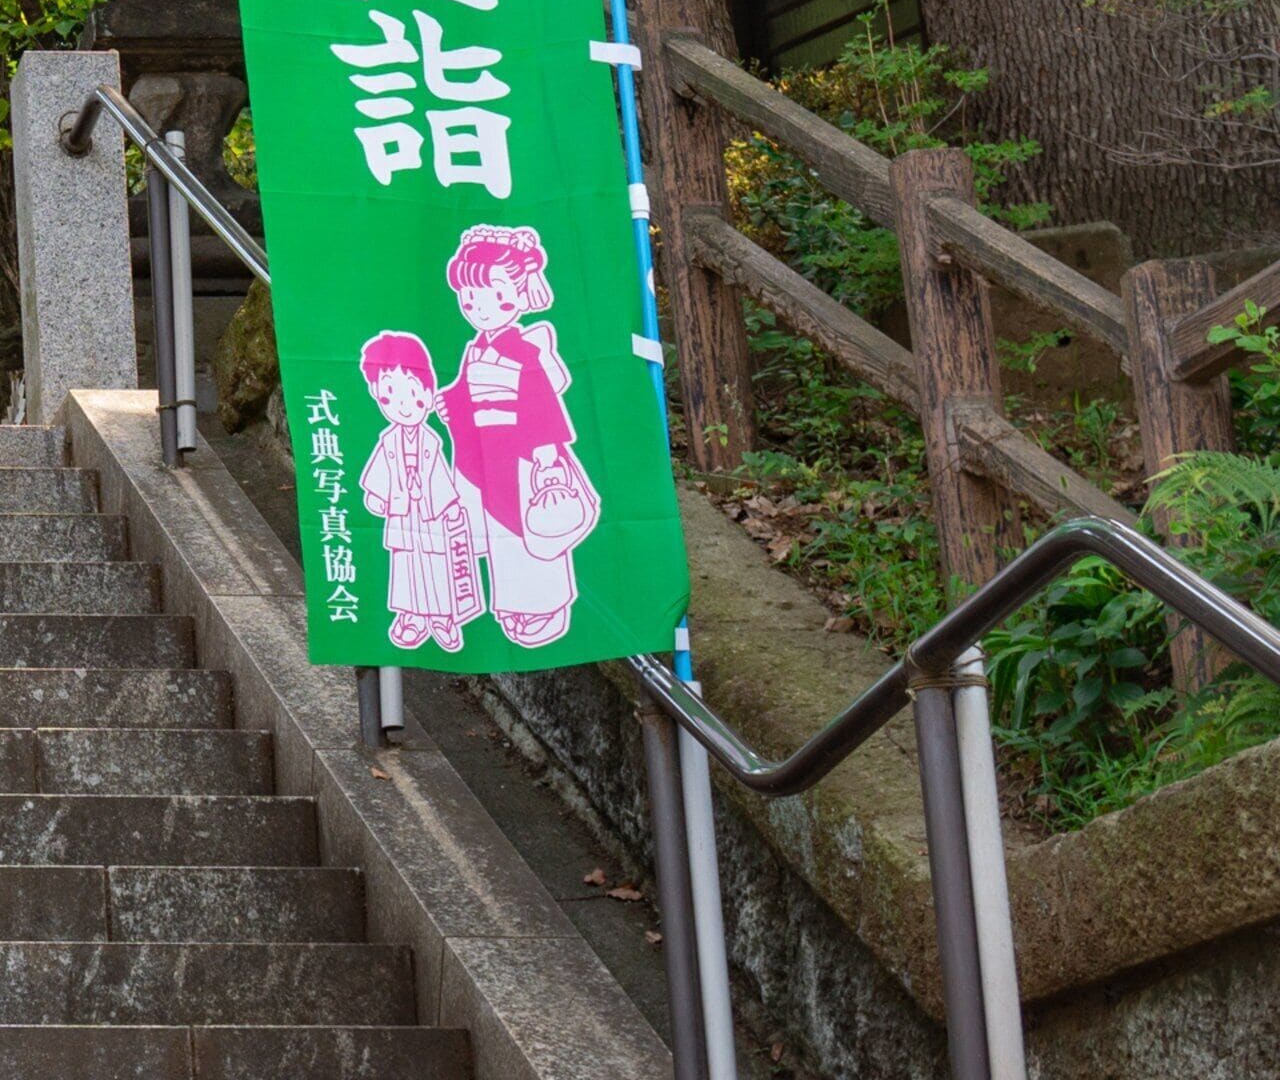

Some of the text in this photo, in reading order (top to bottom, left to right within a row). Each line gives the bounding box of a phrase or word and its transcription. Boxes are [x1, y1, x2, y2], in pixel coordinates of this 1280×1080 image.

[303, 389, 359, 623] 式典写真協会
[449, 540, 474, 601] 七五三
